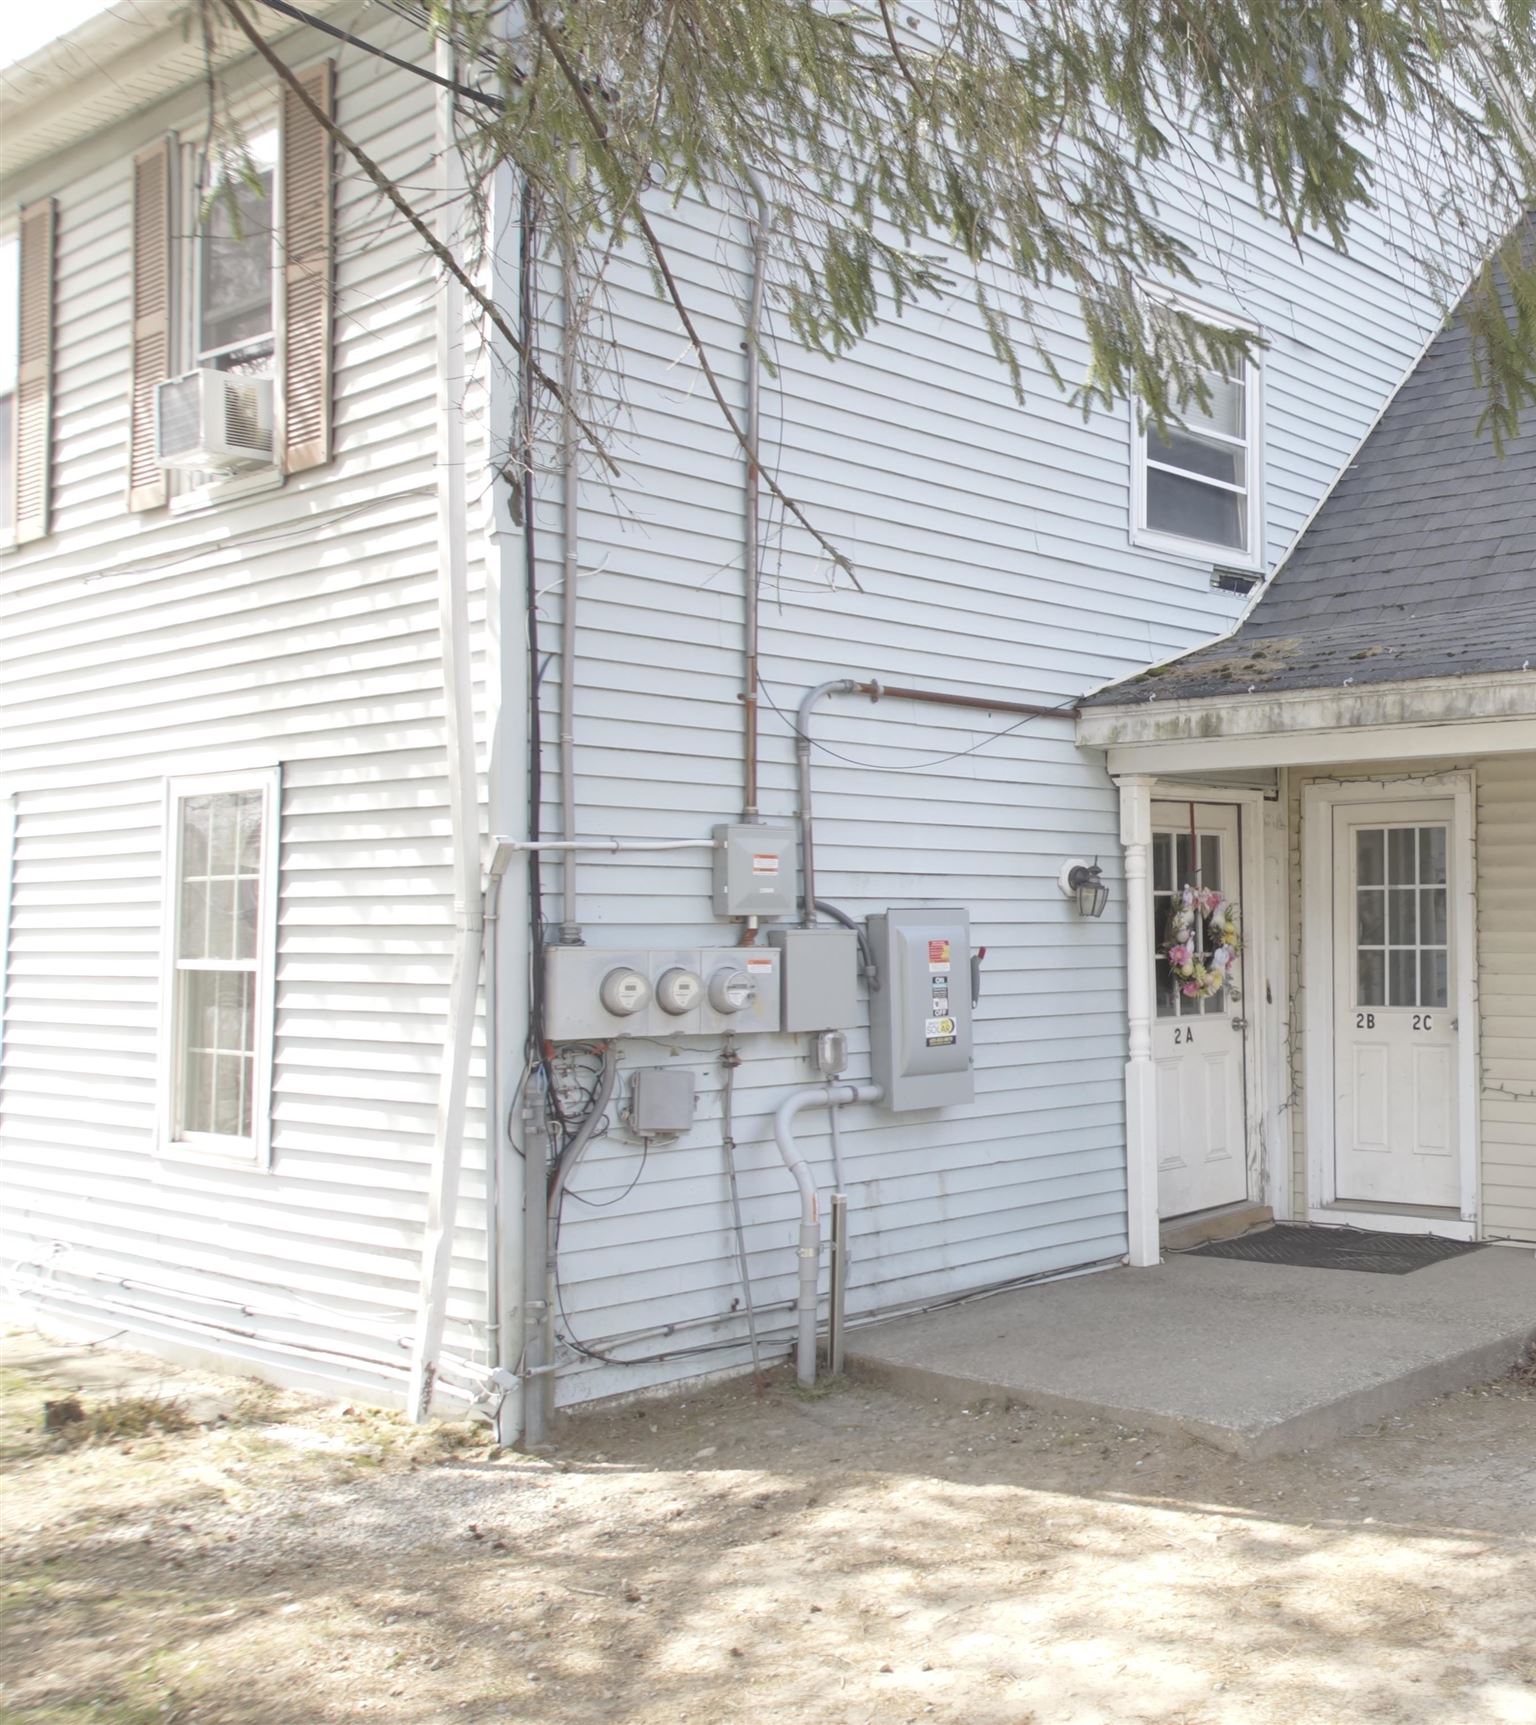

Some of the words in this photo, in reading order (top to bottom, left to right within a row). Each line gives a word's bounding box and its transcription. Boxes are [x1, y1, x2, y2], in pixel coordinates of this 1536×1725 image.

[927, 1024, 950, 1034] SOLAR
[1356, 1013, 1375, 1029] 2B
[1413, 1015, 1432, 1031] 2C
[1174, 1026, 1194, 1045] 2A
